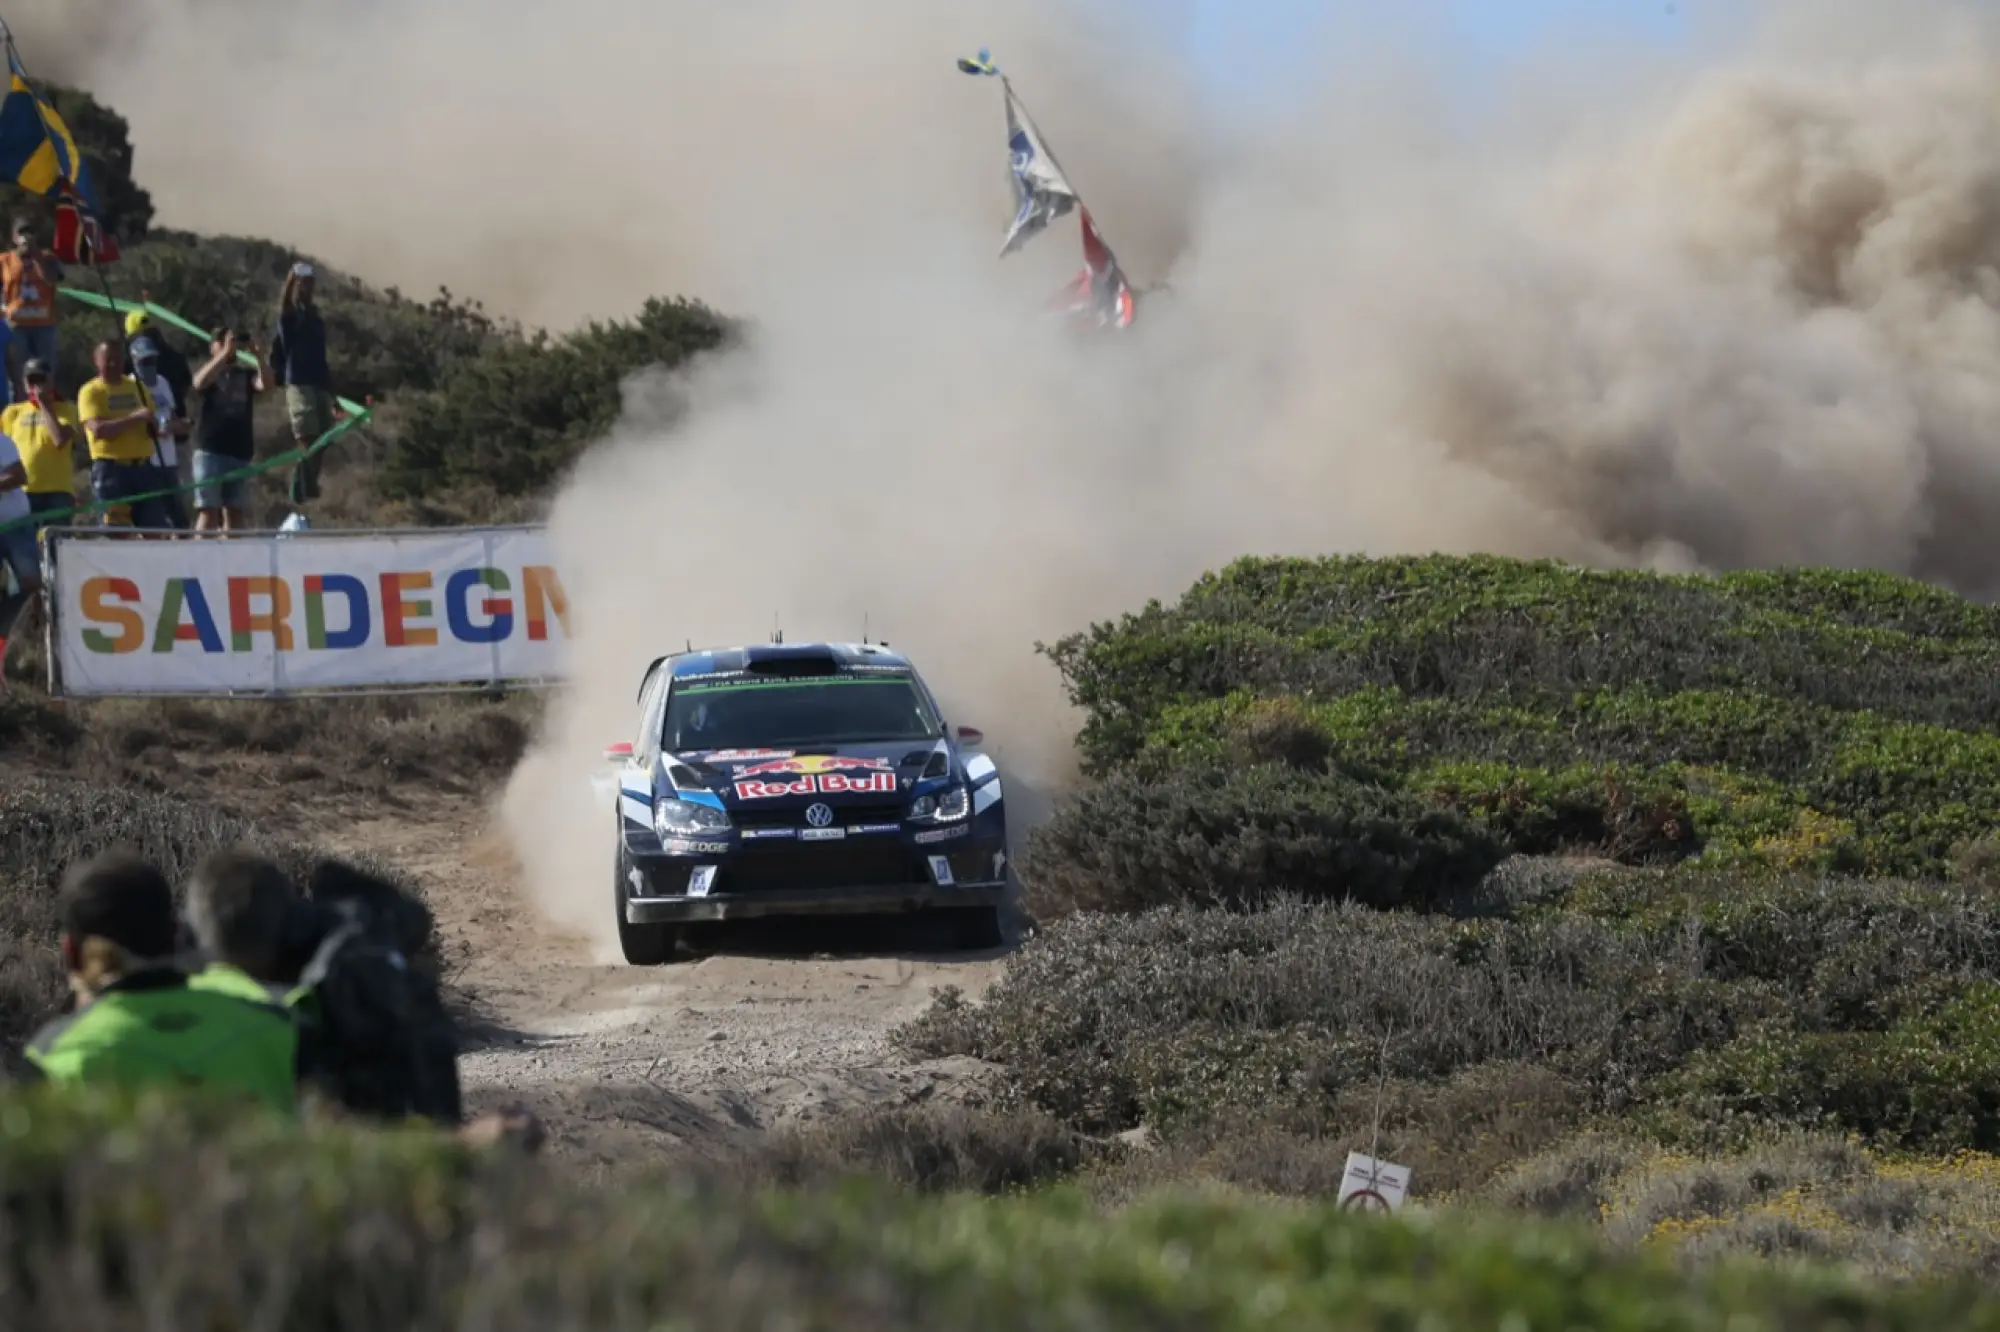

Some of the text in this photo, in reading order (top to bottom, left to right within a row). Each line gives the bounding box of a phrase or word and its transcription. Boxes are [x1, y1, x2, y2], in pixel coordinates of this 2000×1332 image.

[736, 772, 896, 800] Red Bull
[689, 841, 729, 853] EDGE
